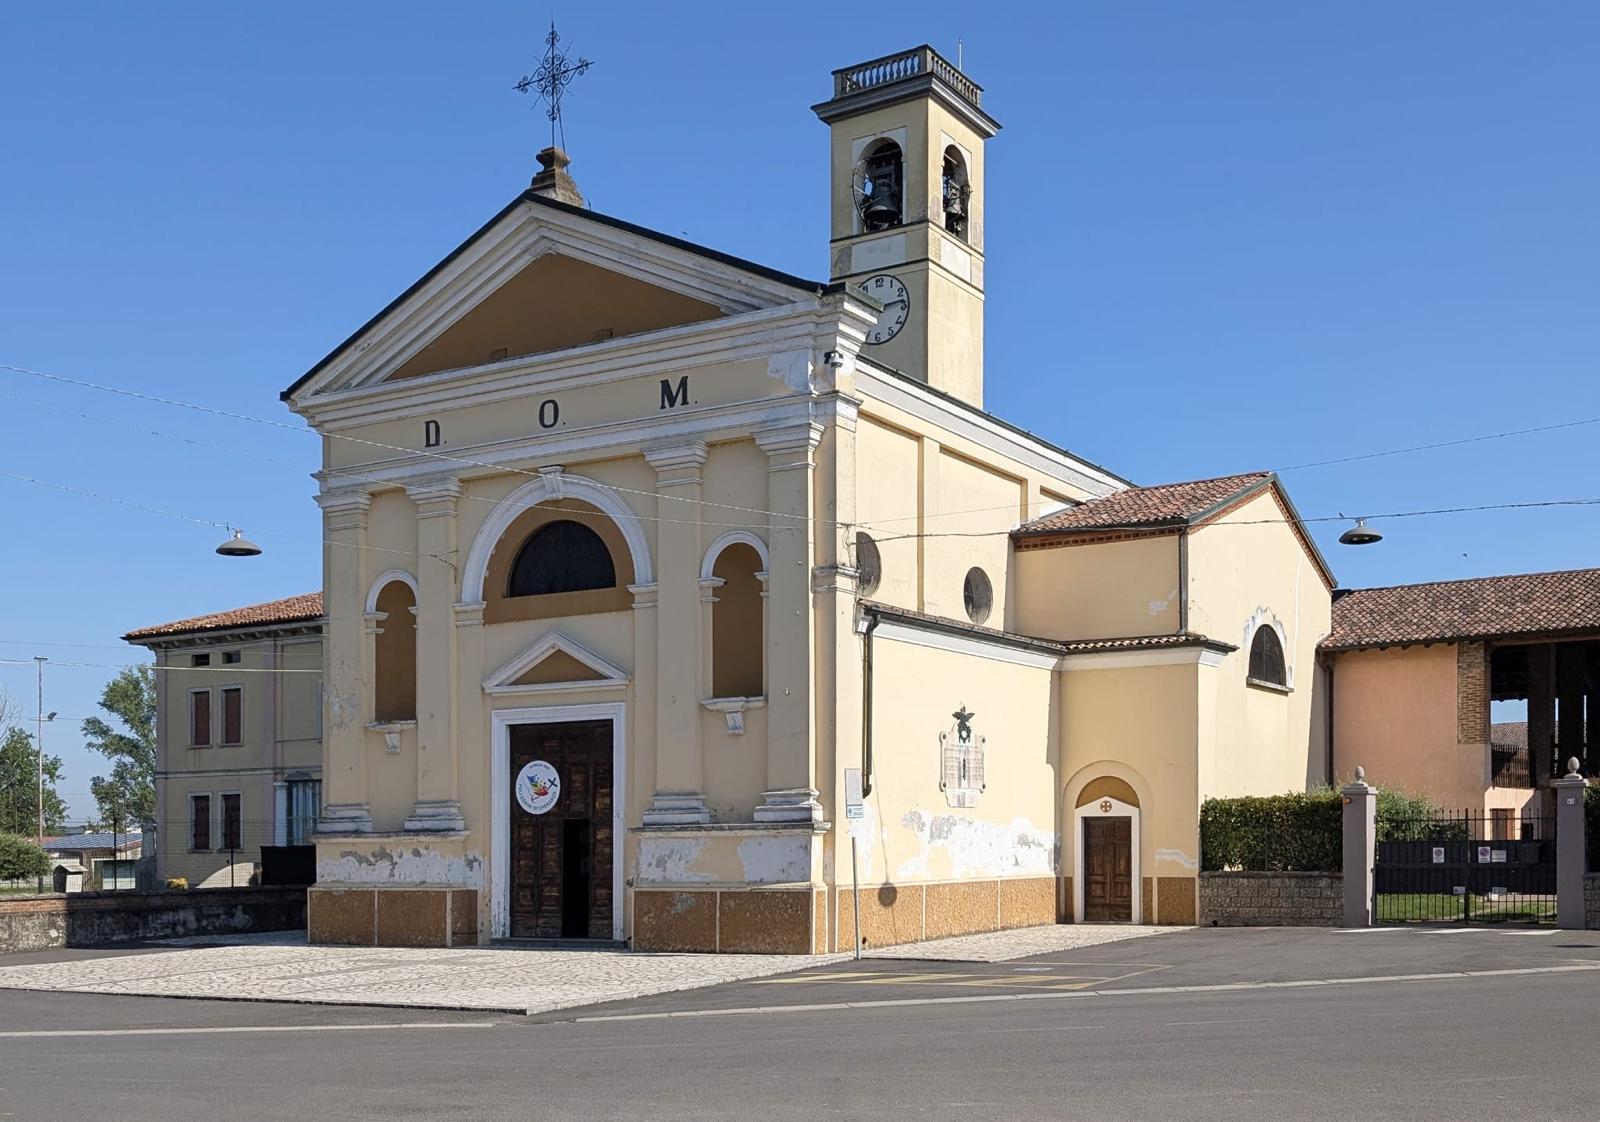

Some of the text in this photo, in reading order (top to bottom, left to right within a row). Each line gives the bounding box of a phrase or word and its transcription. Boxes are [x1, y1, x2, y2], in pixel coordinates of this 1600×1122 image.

[875, 278, 884, 288] 12
[897, 288, 903, 297] 2
[901, 299, 907, 310] 3
[888, 327, 893, 336] 5
[875, 333, 881, 342] 6
[424, 376, 698, 447] D. O. M.
